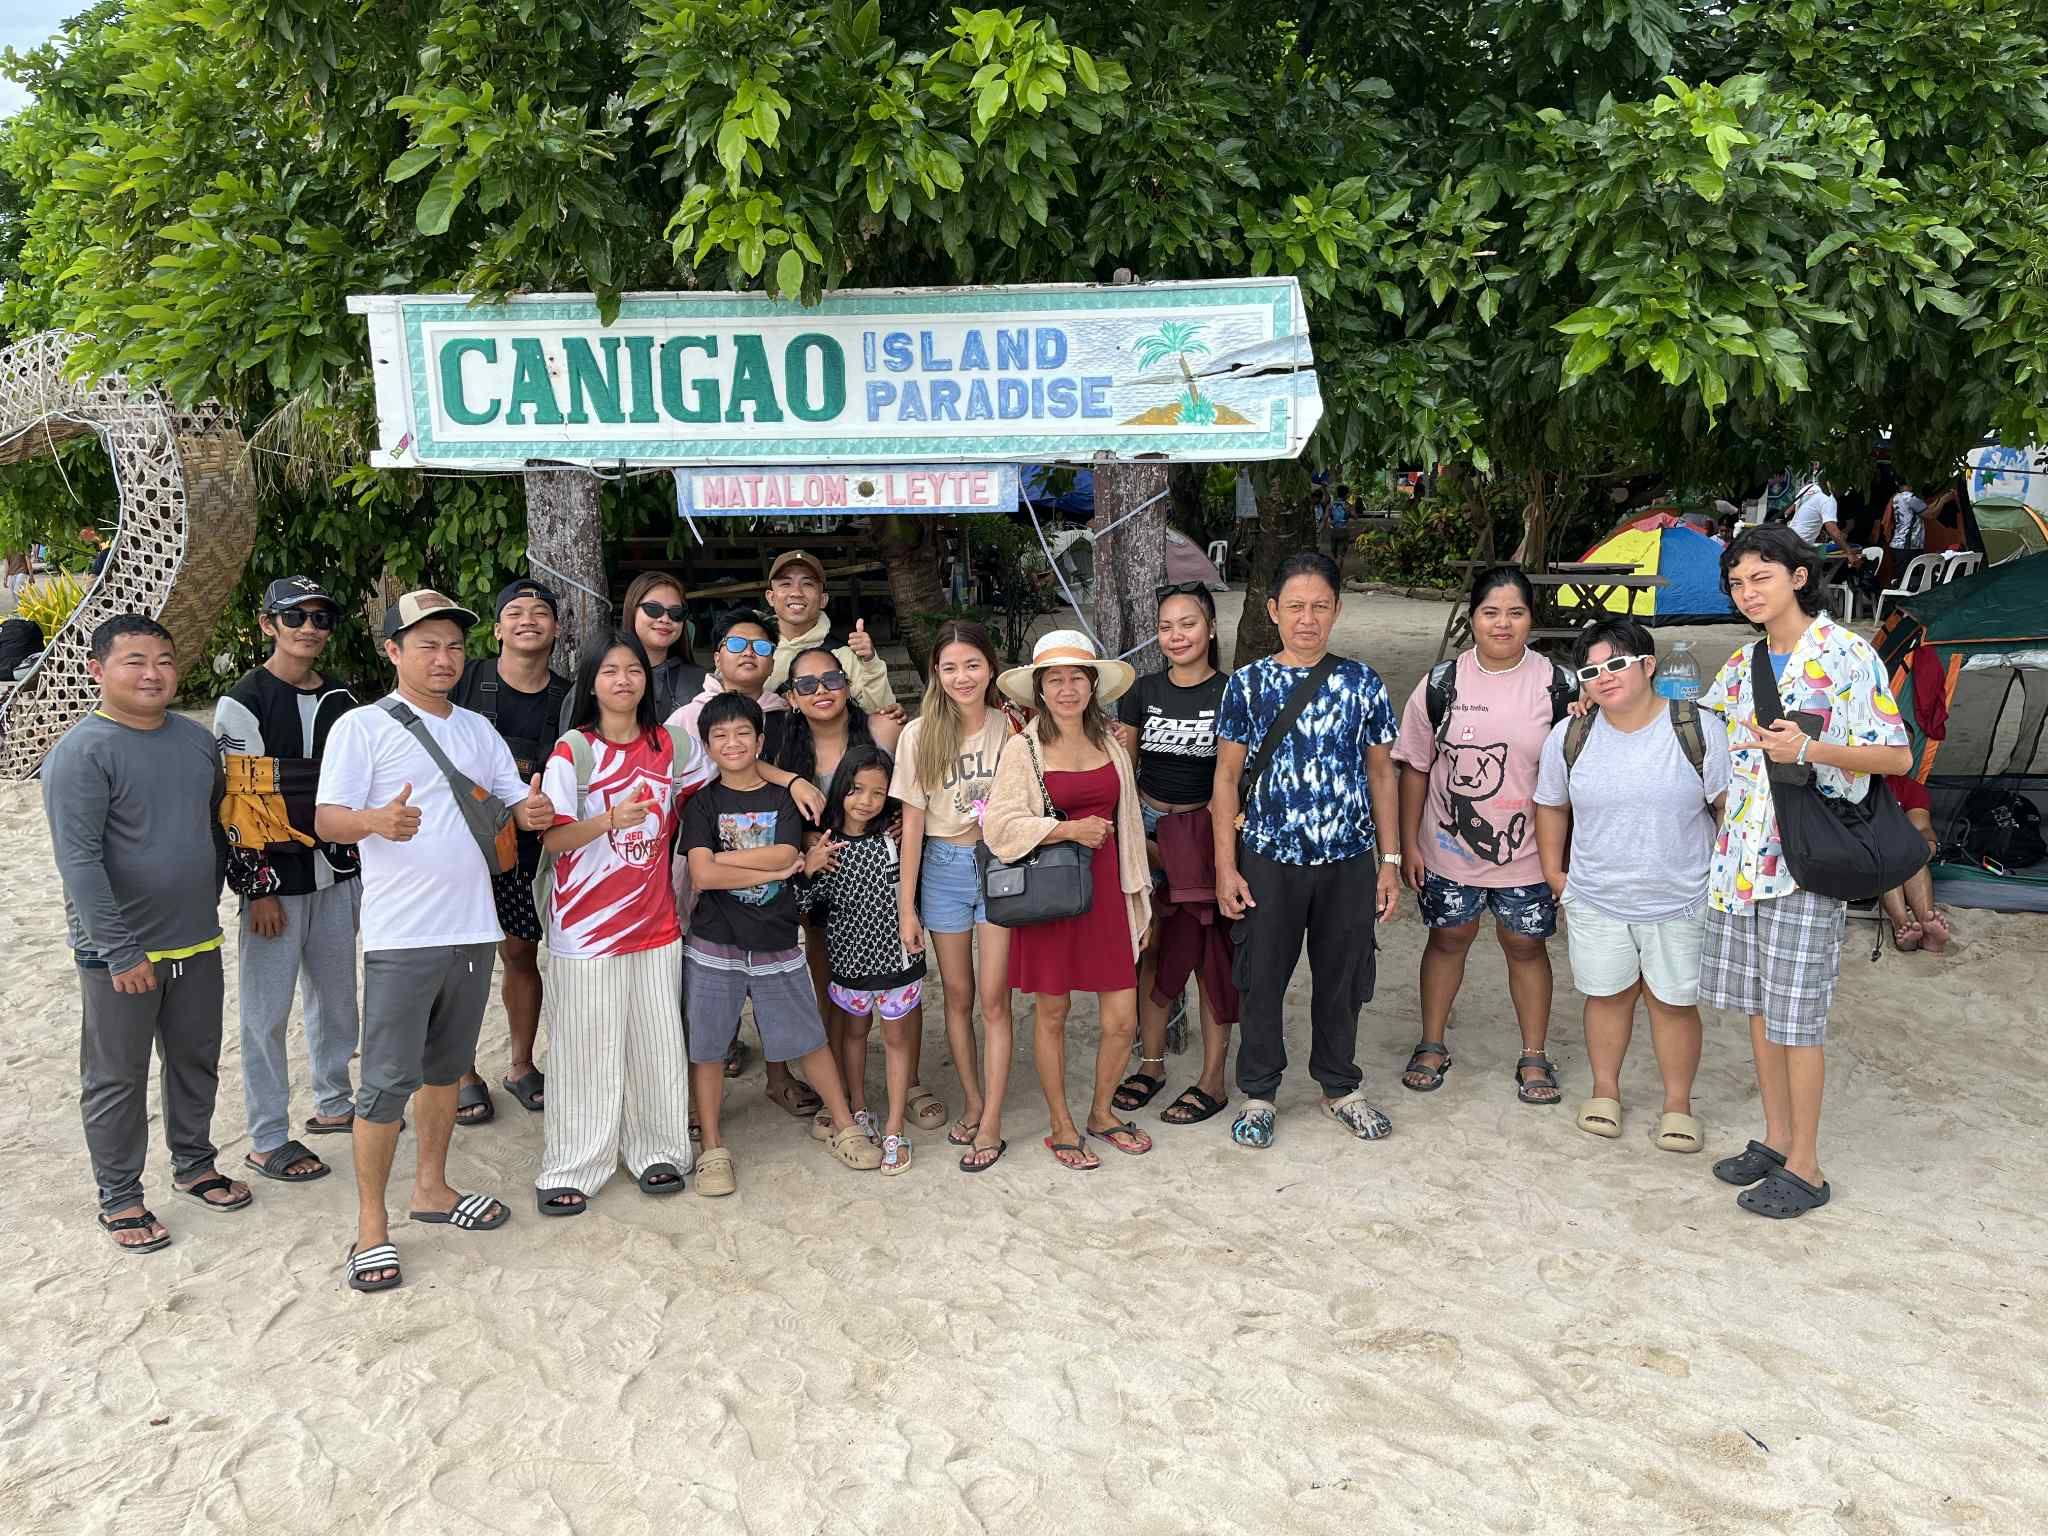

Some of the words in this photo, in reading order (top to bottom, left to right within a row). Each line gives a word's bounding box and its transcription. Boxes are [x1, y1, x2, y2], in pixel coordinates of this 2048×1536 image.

[863, 327, 1069, 373] ISLAND
[439, 333, 846, 426] CANIGAO
[866, 375, 1114, 422] PARADISE
[703, 475, 848, 508] MATALOM
[885, 470, 990, 506] LEYTE
[1141, 728, 1215, 746] MOTO
[1144, 716, 1216, 732] RACE
[624, 831, 643, 841] RED
